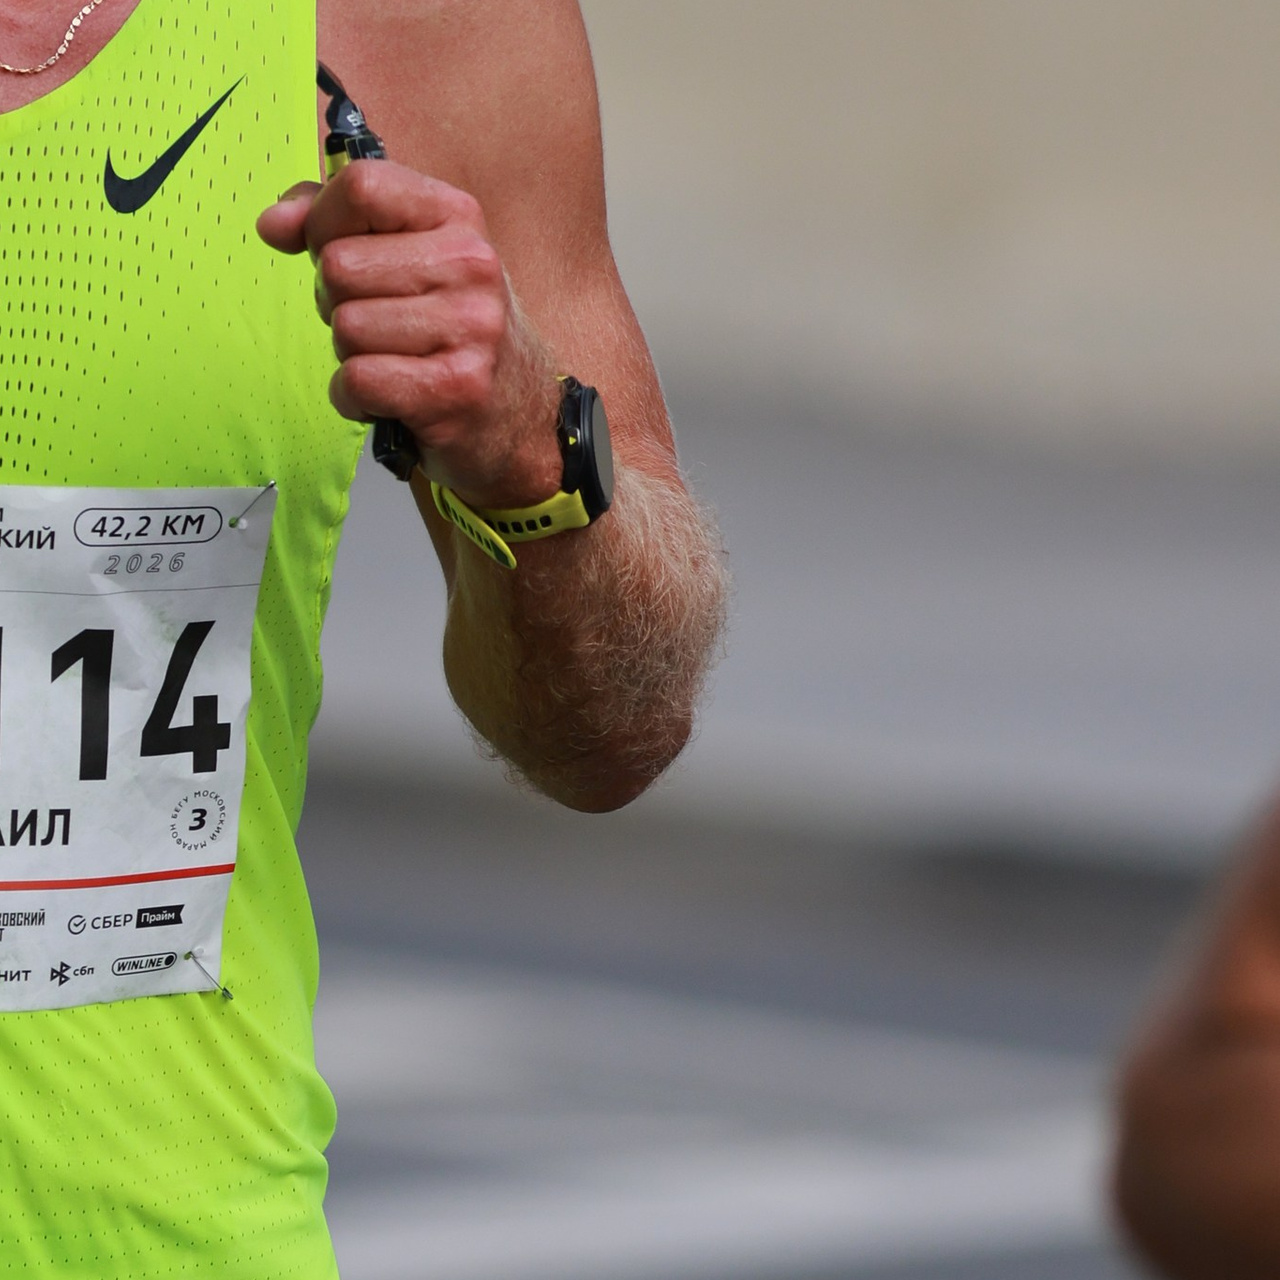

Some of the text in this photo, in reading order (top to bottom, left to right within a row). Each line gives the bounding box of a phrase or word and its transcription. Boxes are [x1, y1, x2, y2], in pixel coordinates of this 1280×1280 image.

[91, 514, 206, 540] 42,2 КМ
[103, 552, 186, 575] 2026
[188, 808, 208, 831] 3
[194, 790, 227, 841] МОСКОВСКИЙ
[170, 823, 207, 851] МАРАФОН
[91, 910, 176, 930] СБЕР Прайм
[73, 965, 95, 977] сбп
[116, 957, 164, 972] WINLINE
